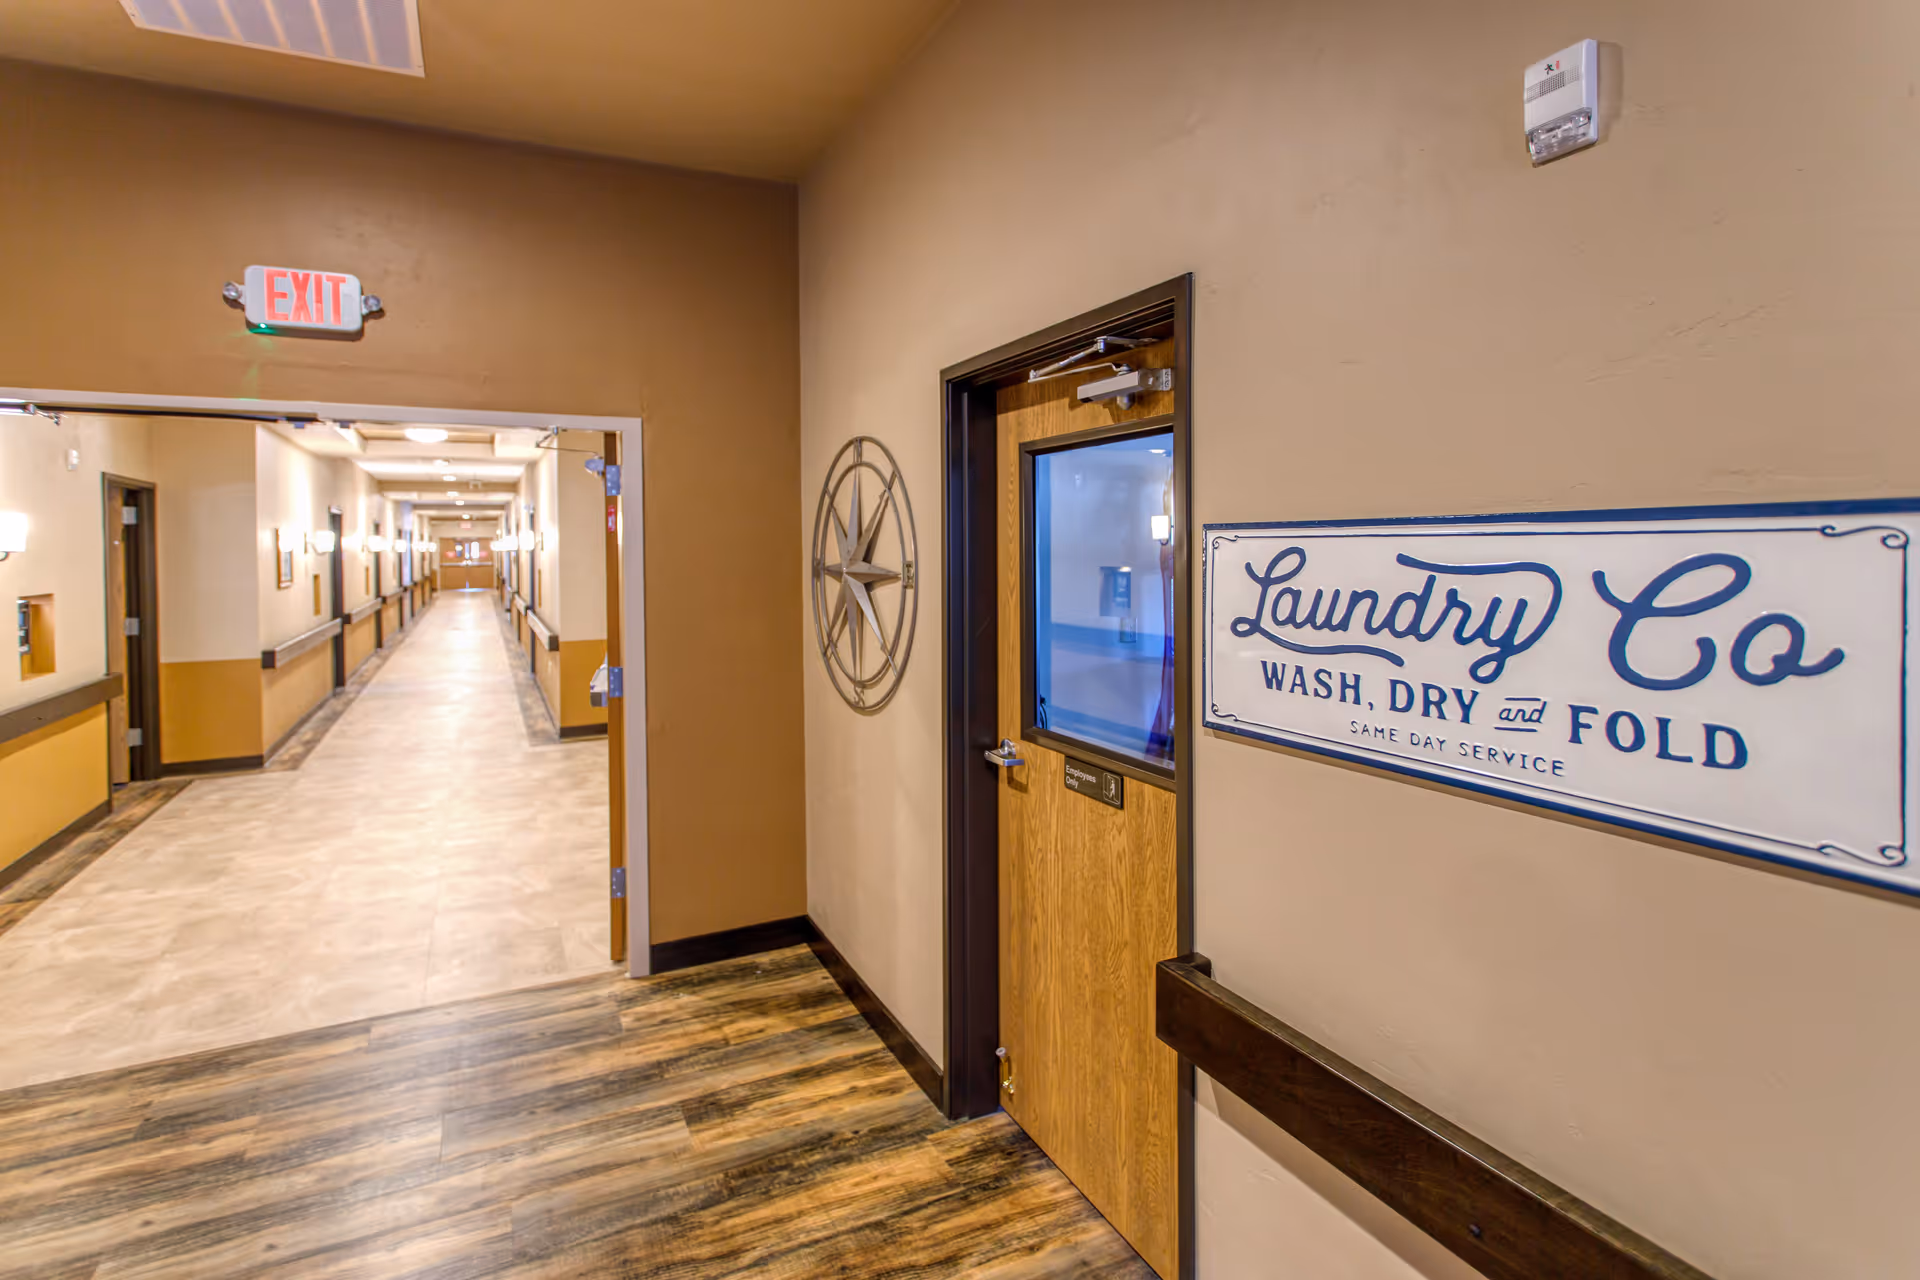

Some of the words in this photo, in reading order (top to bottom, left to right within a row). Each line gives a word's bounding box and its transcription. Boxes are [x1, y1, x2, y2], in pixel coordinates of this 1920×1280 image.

[264, 268, 346, 326] EXIT
[1231, 546, 1563, 684] Laundry
[1592, 552, 1845, 691] Co
[1260, 660, 1375, 712] WASH,
[1388, 679, 1480, 724] DRY
[1498, 700, 1547, 725] and
[1568, 704, 1749, 770] FOLD
[1065, 765, 1097, 783] Employees
[1349, 720, 1400, 743] SAME
[1410, 734, 1447, 752] DAY
[1459, 742, 1565, 777] SERVICE
[1065, 776, 1079, 789] Only
